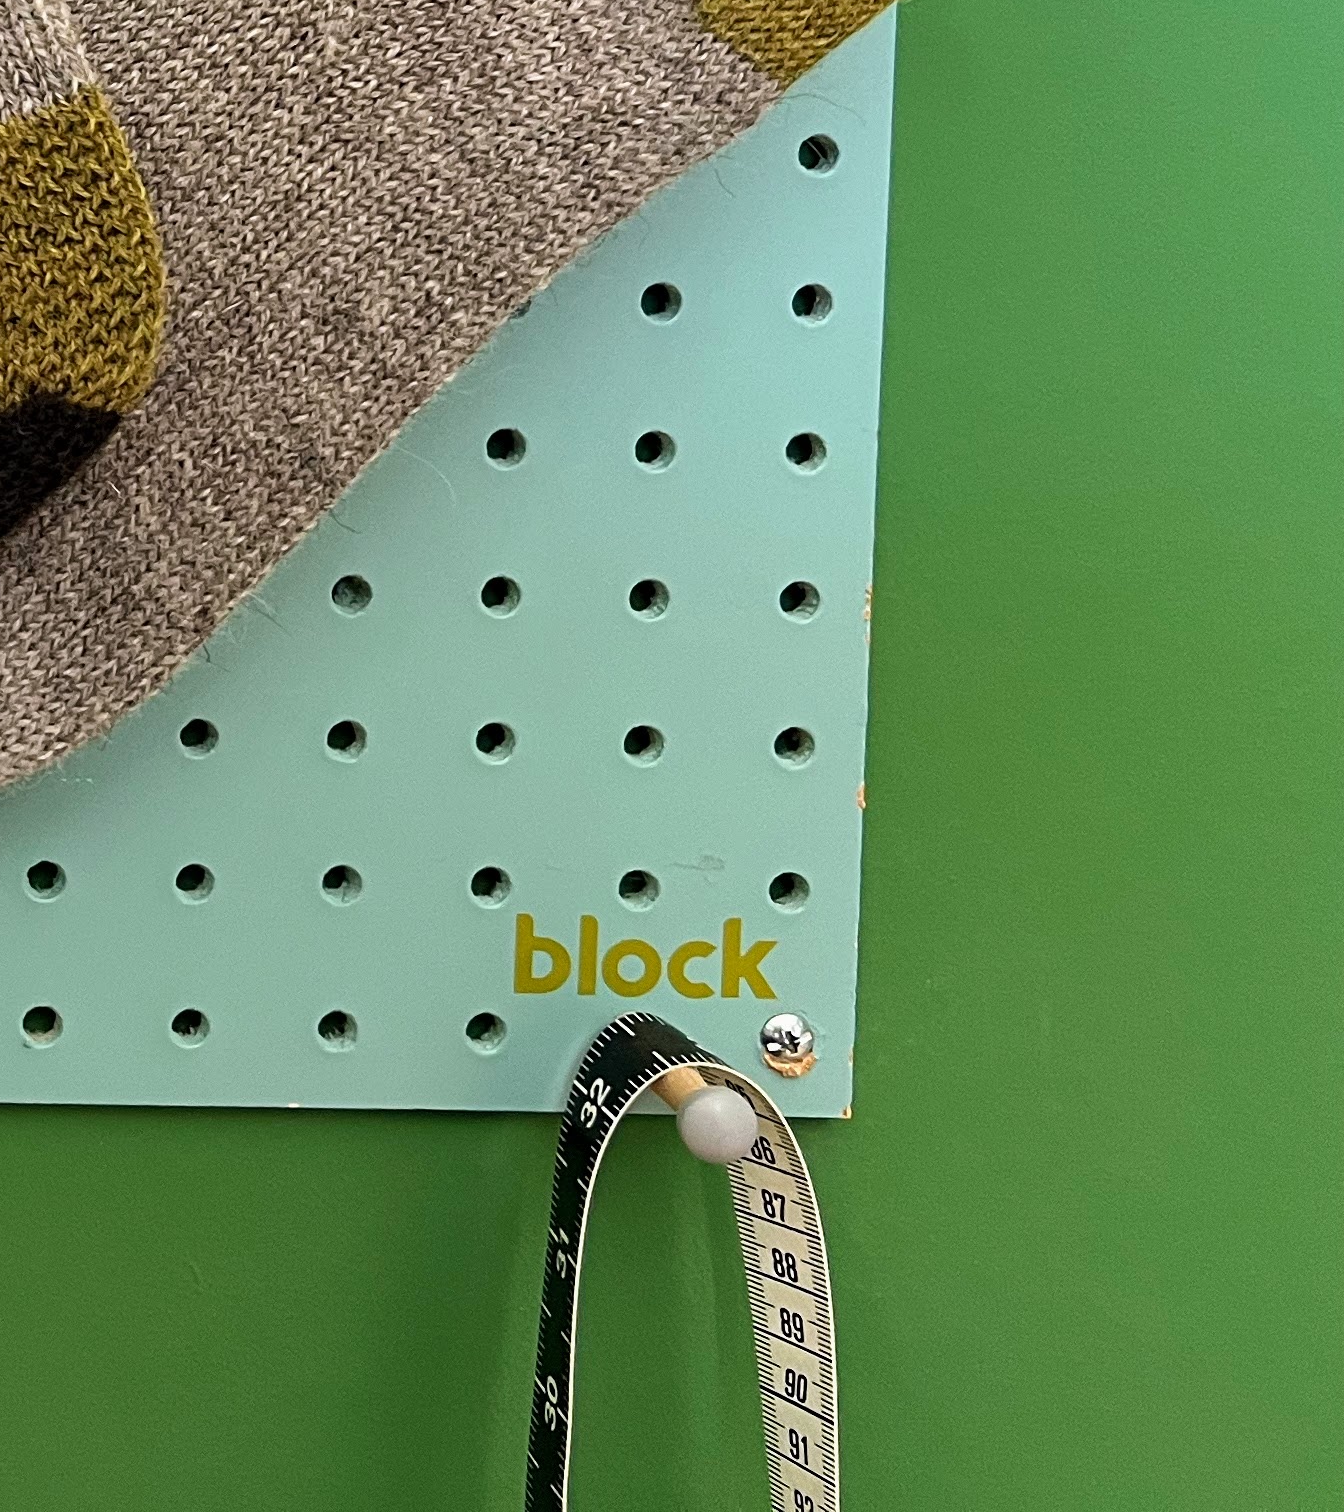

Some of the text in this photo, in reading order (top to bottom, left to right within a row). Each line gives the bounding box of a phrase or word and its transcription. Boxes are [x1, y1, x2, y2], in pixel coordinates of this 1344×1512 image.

[513, 912, 779, 1000] block
[580, 1077, 611, 1128] 32
[761, 1188, 786, 1223] 87
[555, 1227, 570, 1279] 31
[771, 1247, 798, 1283] 88
[779, 1307, 805, 1344] 89
[544, 1375, 559, 1432] 30
[784, 1368, 808, 1404] 90
[788, 1428, 809, 1466] 91
